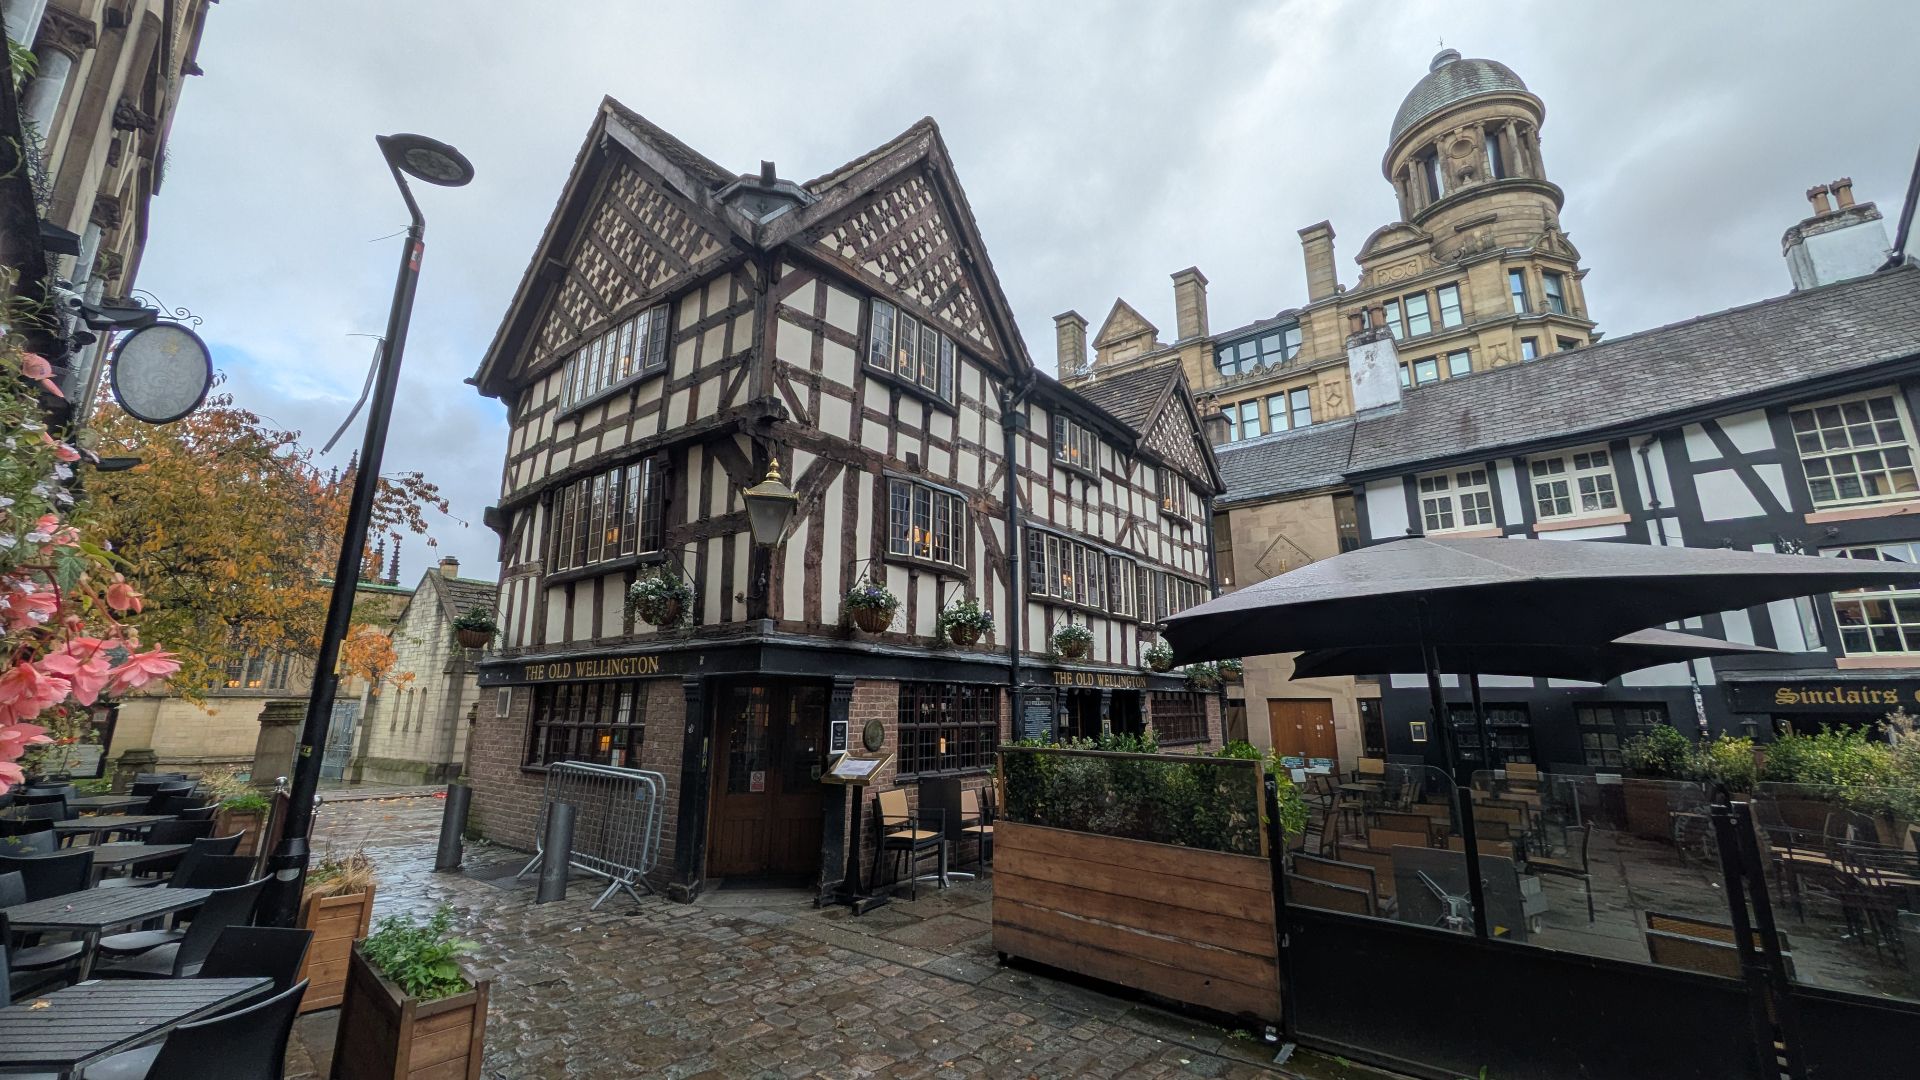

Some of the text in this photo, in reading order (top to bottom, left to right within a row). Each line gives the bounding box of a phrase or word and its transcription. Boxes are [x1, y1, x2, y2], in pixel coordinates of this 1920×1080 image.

[525, 656, 659, 681] THE OLD WELLINGTON
[1053, 671, 1147, 688] THE OLD WELLINGTON
[1775, 686, 1899, 705] Sinclairs
